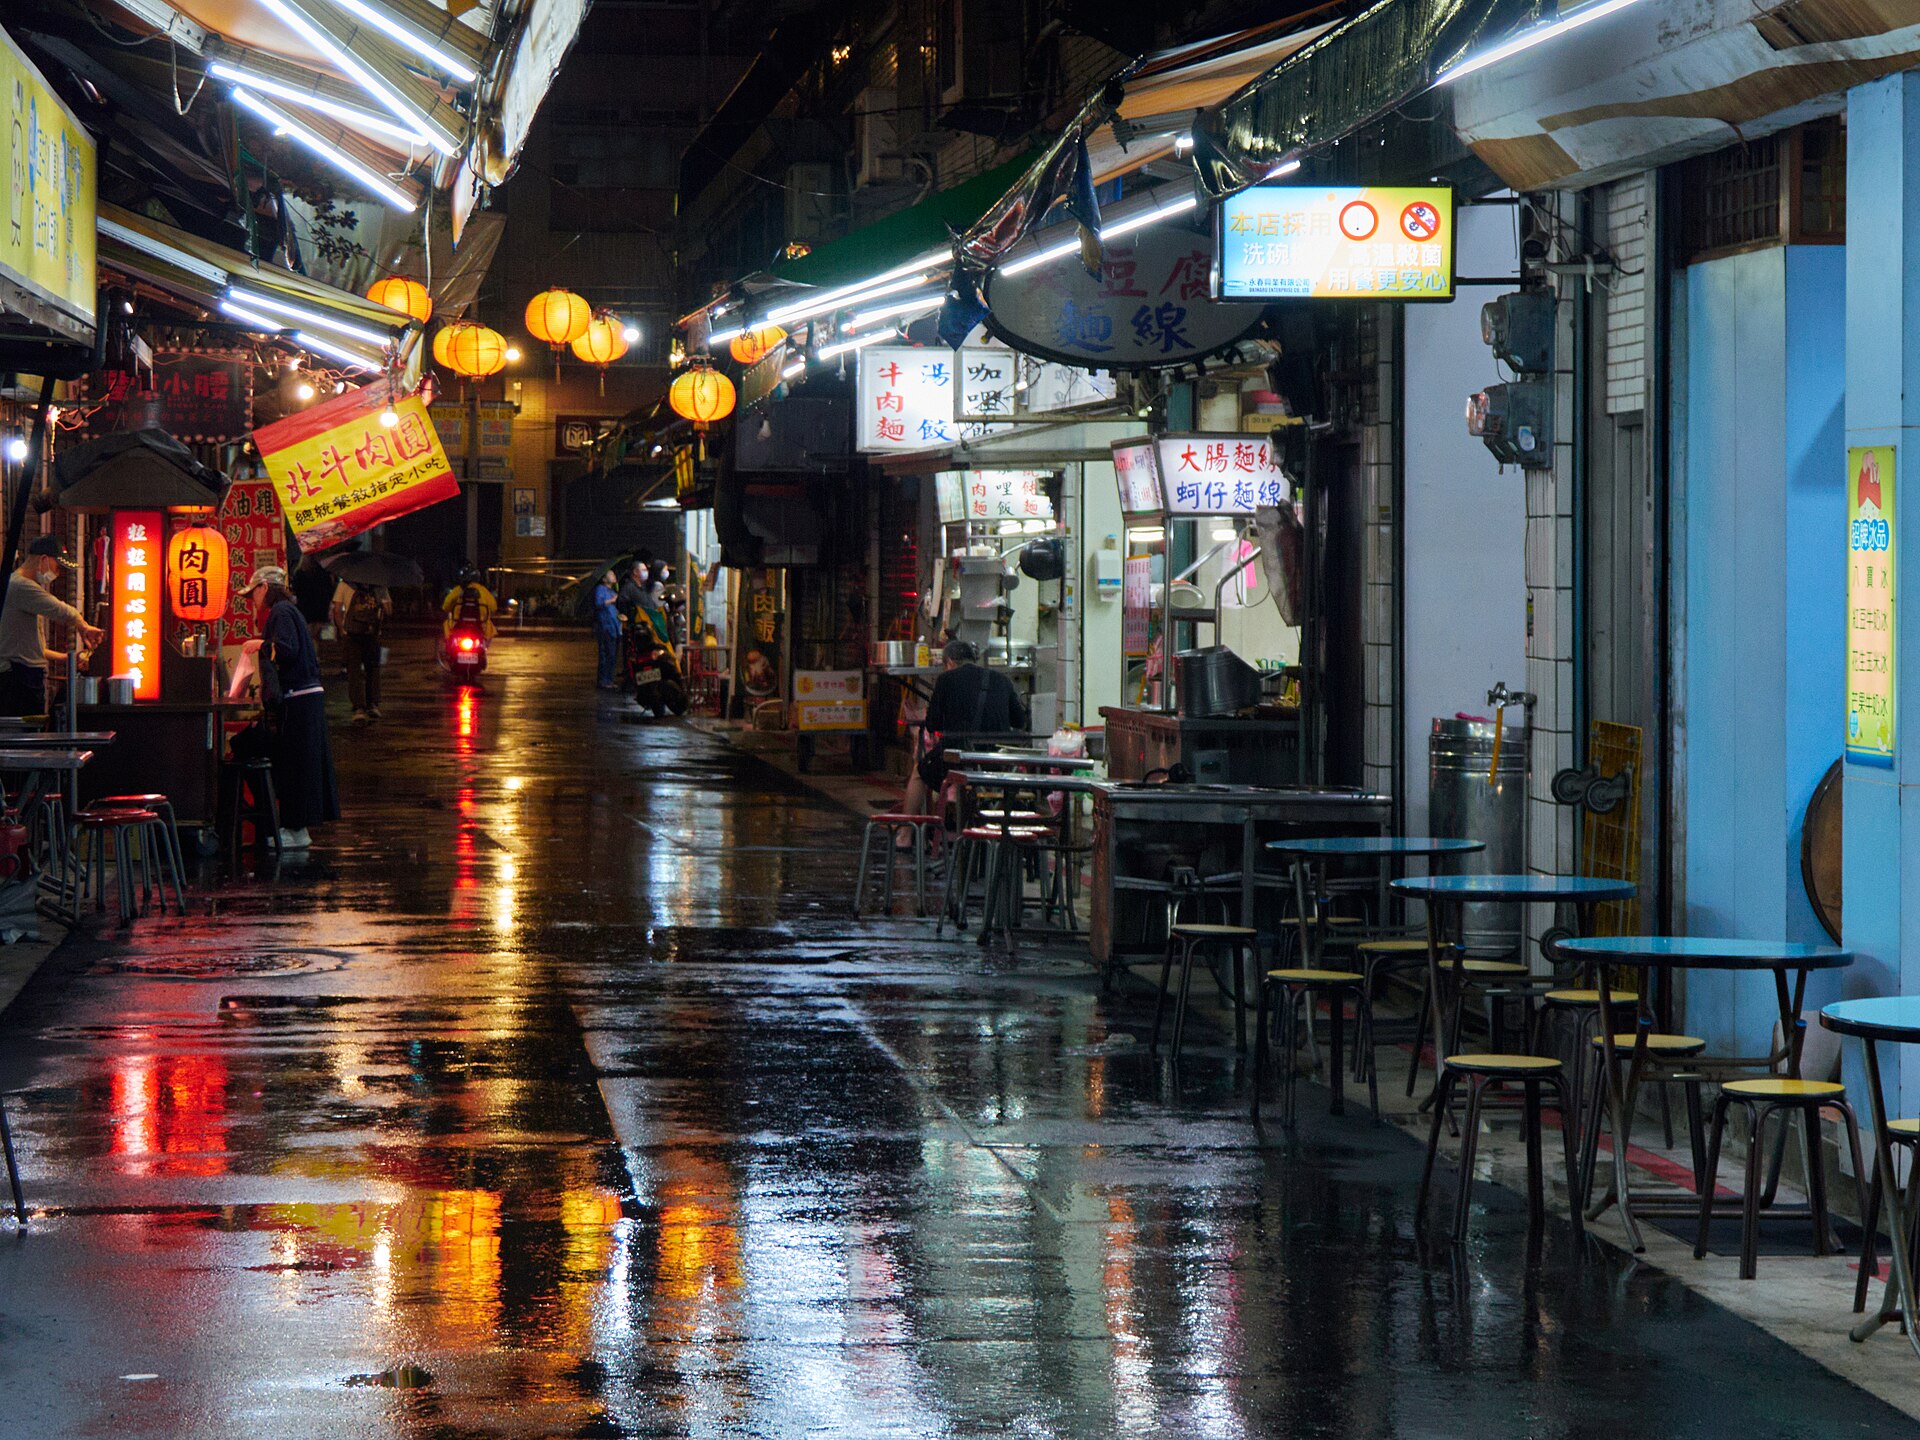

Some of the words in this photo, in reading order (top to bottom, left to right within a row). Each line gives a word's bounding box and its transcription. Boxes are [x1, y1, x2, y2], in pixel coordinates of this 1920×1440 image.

[1229, 210, 1331, 236] 本店採用
[1328, 269, 1447, 291] 用餐更安心
[1055, 299, 1197, 351] 麵線
[875, 361, 906, 442] 牛肉麵
[285, 412, 432, 504] 北斗肉圓
[295, 457, 446, 527] 總統餐敘指定小吃
[995, 470, 1015, 516] 哩飯
[1176, 479, 1281, 511] 蚵仔麵線
[1852, 521, 1888, 549] 招牌冰品
[179, 542, 209, 609] 肉圓
[1853, 608, 1888, 631] 紅豆牛奶冰
[1852, 650, 1888, 673] 花生玉米冰
[1851, 691, 1888, 717] 芒果牛奶冰
